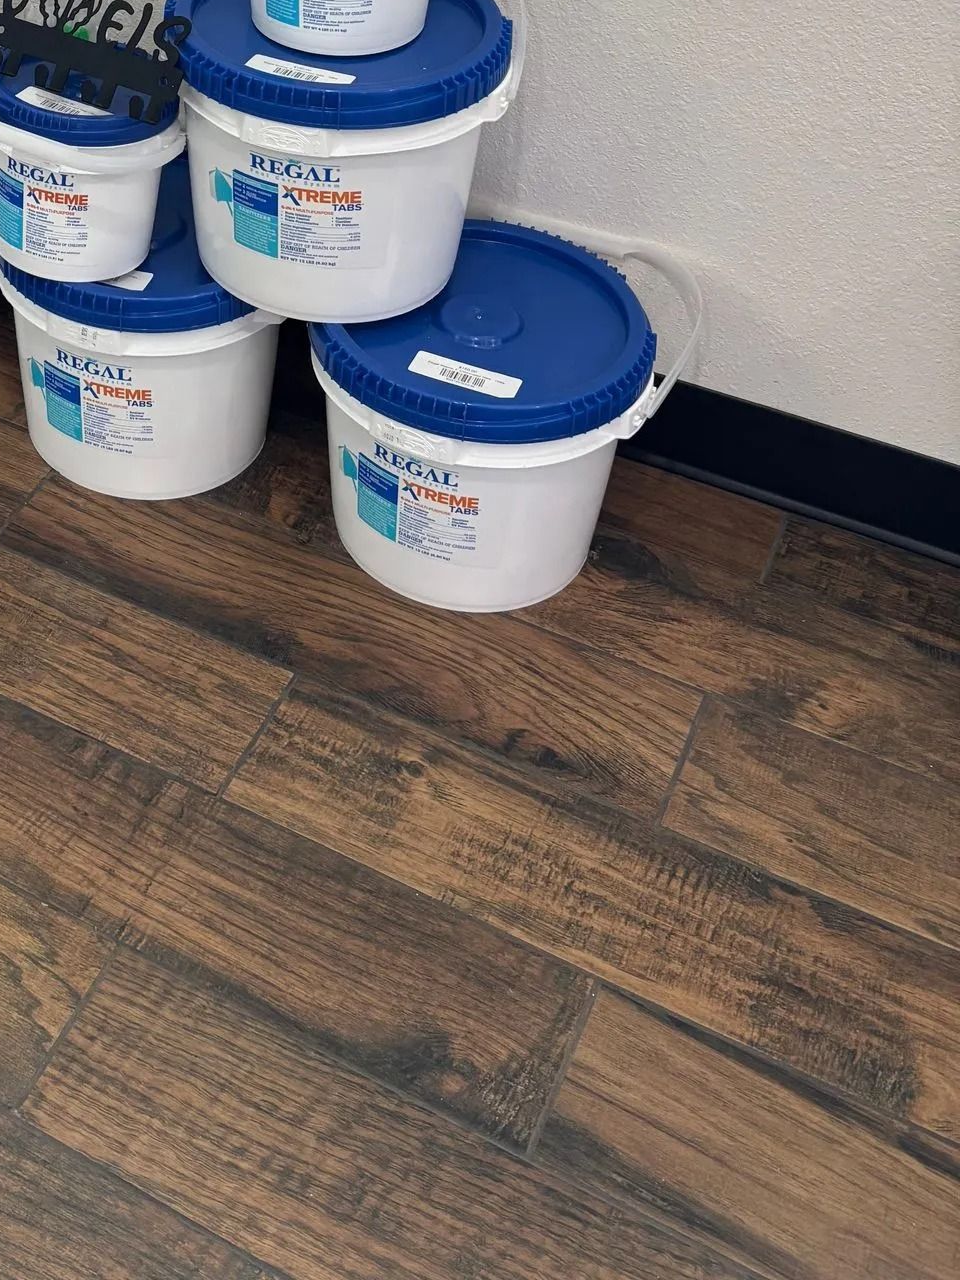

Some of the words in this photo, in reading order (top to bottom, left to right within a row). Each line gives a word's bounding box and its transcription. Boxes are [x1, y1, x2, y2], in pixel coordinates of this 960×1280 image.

[8, 157, 73, 187] REGAL
[249, 153, 340, 182] REGAL
[27, 185, 88, 204] XTREME
[282, 185, 361, 206] XTREME
[56, 348, 132, 381] REGAL
[83, 380, 152, 401] XTREME
[374, 442, 458, 487] REGAL
[402, 478, 479, 508] XTREME
[449, 506, 479, 515] TABS
